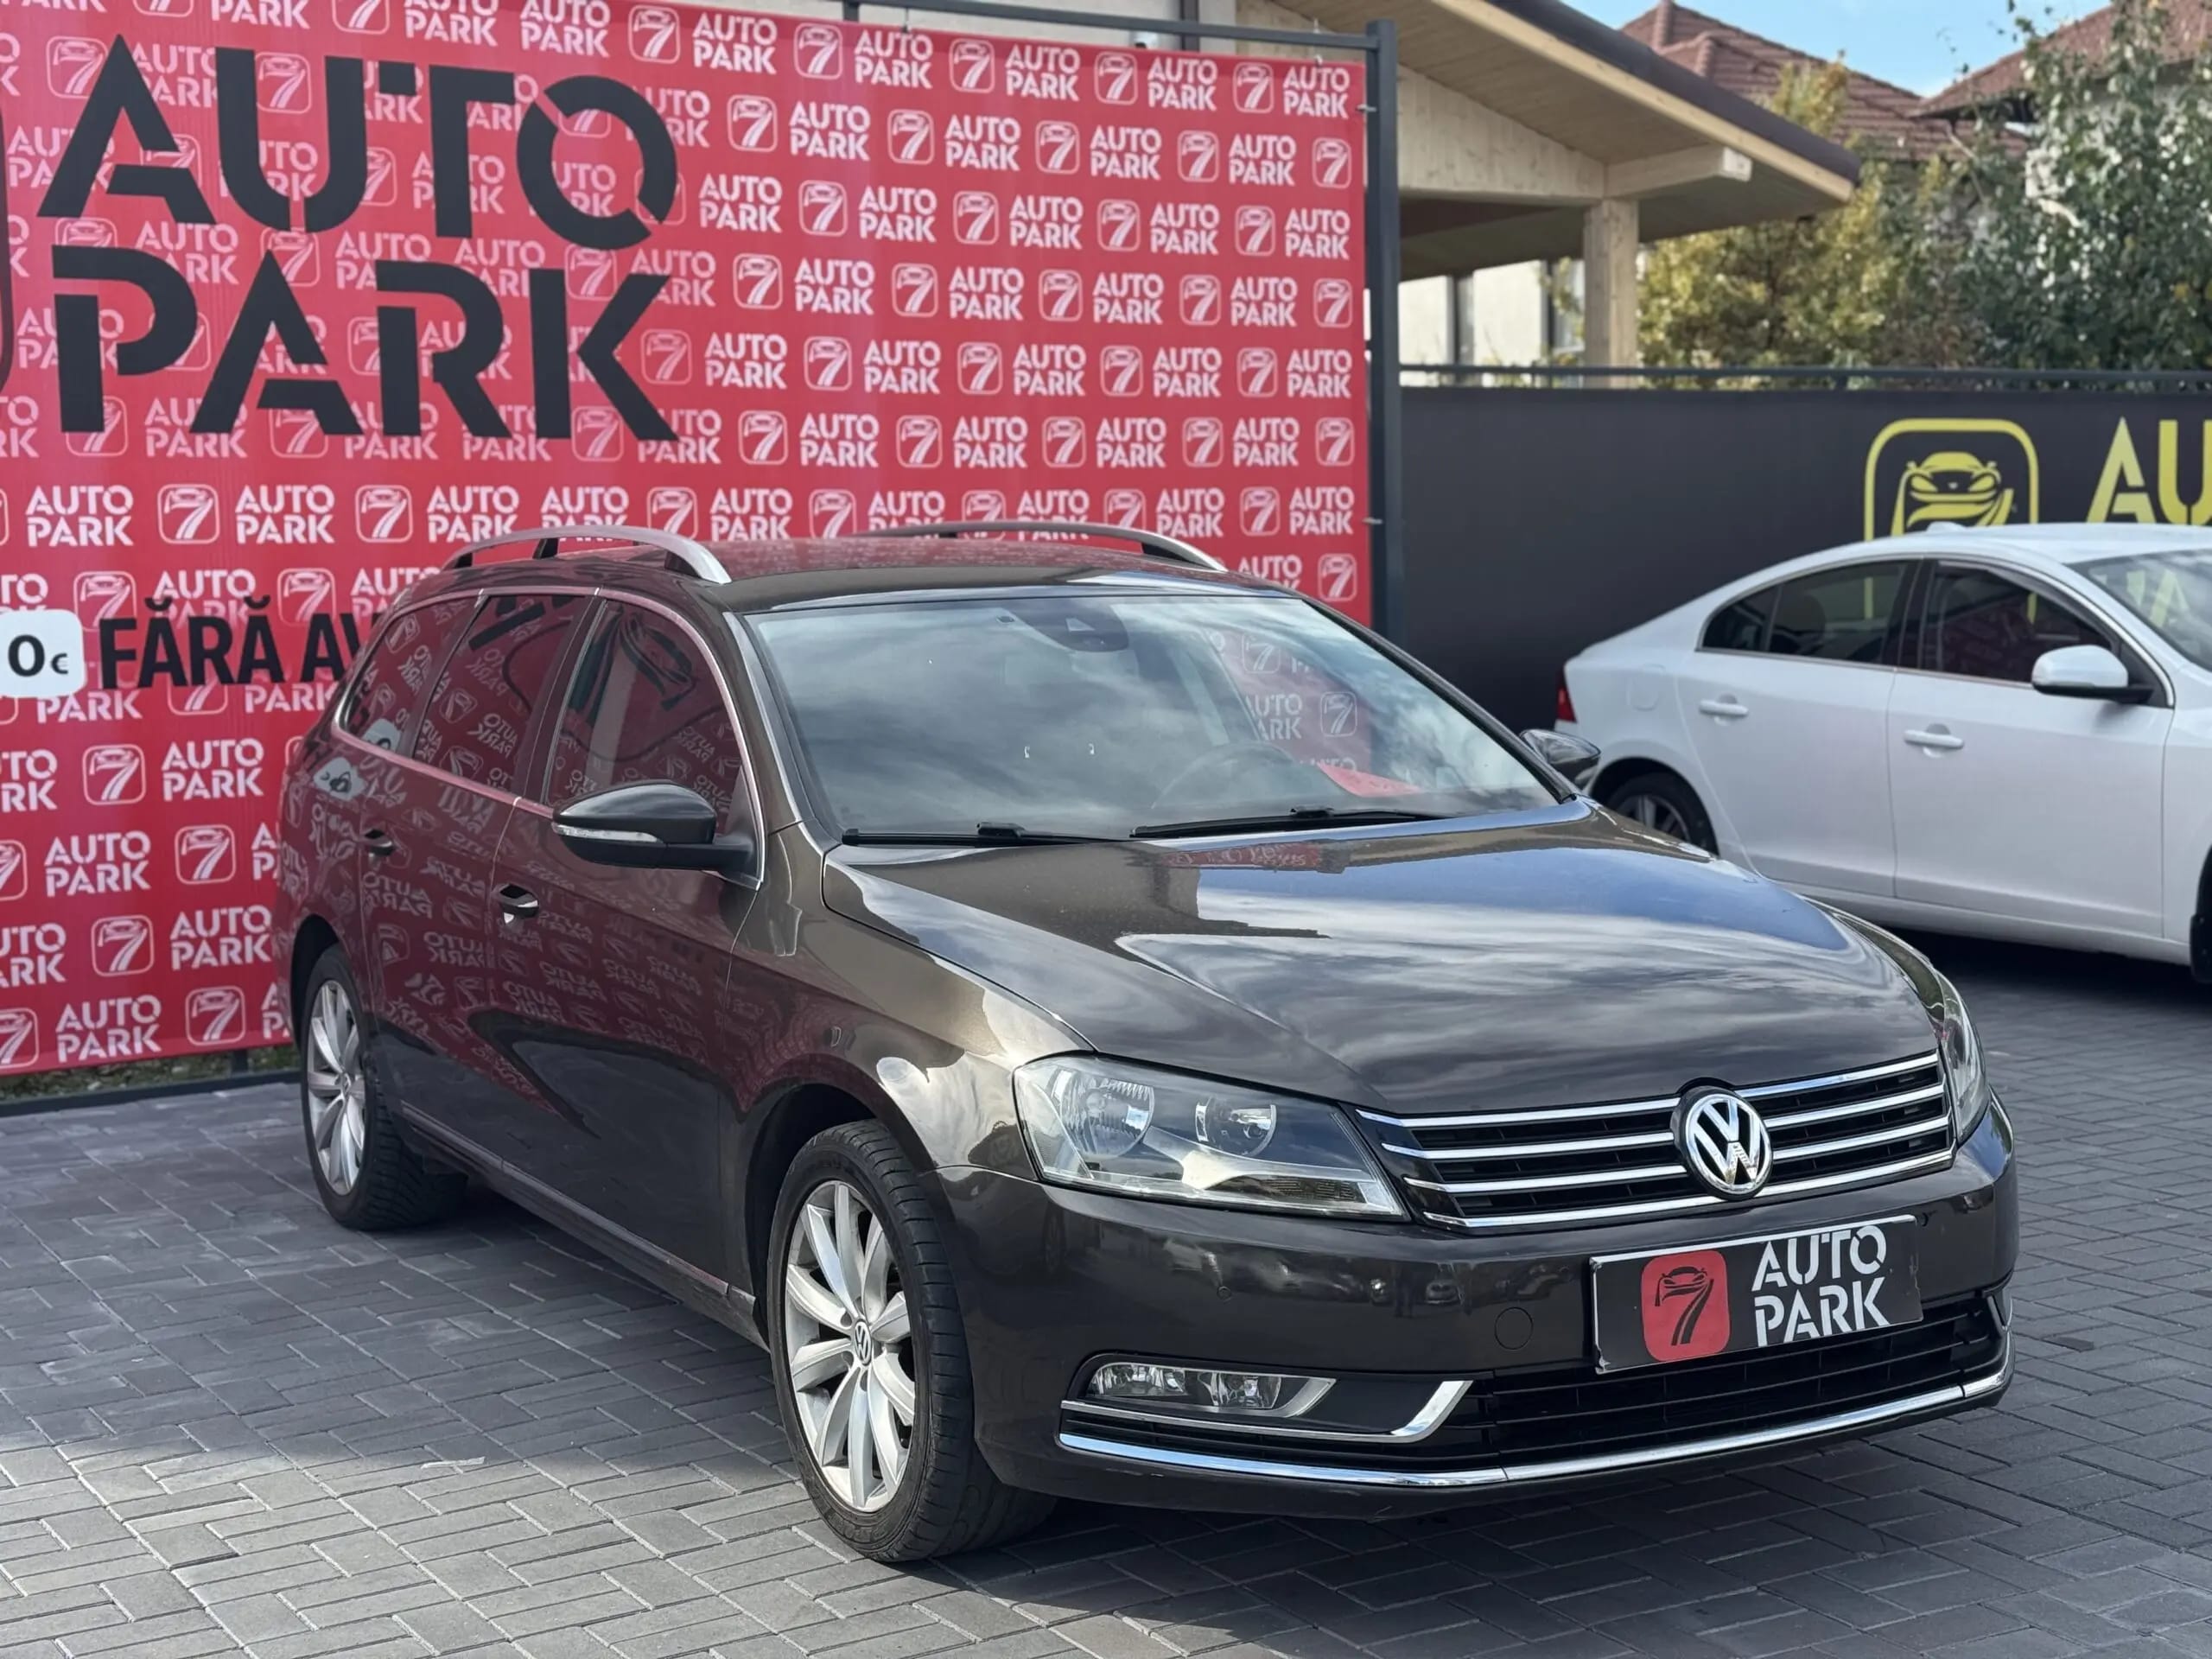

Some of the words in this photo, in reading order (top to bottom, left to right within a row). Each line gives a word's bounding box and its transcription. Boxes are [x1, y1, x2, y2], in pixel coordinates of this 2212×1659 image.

[211, 0, 310, 29] PARK
[405, 9, 499, 47] PARK
[519, 0, 611, 29] AUTO
[520, 20, 610, 58] PARK
[692, 14, 777, 46] AUTO
[693, 38, 777, 75] PARK
[854, 30, 933, 61] AUTO
[1005, 46, 1080, 74] AUTO
[855, 55, 933, 90] PARK
[1006, 68, 1079, 102] PARK
[1147, 58, 1217, 86] AUTO
[1282, 67, 1351, 93] AUTO
[1147, 80, 1217, 111] PARK
[1283, 89, 1349, 119] PARK
[789, 100, 871, 134] AUTO
[944, 114, 1021, 144] AUTO
[37, 34, 677, 251] AUTO
[790, 127, 870, 162] PARK
[945, 139, 1020, 172] PARK
[1090, 127, 1162, 155] AUTO
[1228, 137, 1297, 161] AUTO
[1090, 149, 1160, 181] PARK
[1229, 156, 1295, 187] PARK
[698, 173, 783, 205] AUTO
[858, 186, 938, 216] AUTO
[699, 200, 782, 233] PARK
[1008, 194, 1084, 224] AUTO
[1149, 202, 1220, 230] AUTO
[1284, 207, 1351, 235] AUTO
[133, 220, 239, 254] AUTO
[859, 211, 937, 243] PARK
[1009, 219, 1083, 250] PARK
[1152, 227, 1219, 256] PARK
[334, 230, 432, 263] AUTO
[453, 238, 546, 269] AUTO
[1285, 230, 1350, 260] PARK
[629, 247, 716, 279] AUTO
[794, 257, 875, 289] AUTO
[949, 266, 1025, 295] AUTO
[1092, 272, 1165, 299] AUTO
[1230, 276, 1298, 302] AUTO
[795, 283, 874, 316] PARK
[950, 292, 1024, 321] PARK
[1093, 296, 1163, 325] PARK
[1230, 300, 1297, 327] PARK
[52, 245, 680, 442] PARK
[704, 332, 788, 362] AUTO
[862, 340, 942, 368] AUTO
[1013, 344, 1087, 371] AUTO
[705, 359, 787, 390] PARK
[1155, 346, 1223, 373] AUTO
[1287, 348, 1352, 374] AUTO
[864, 365, 941, 395] PARK
[1014, 368, 1086, 397] PARK
[1155, 372, 1222, 397] PARK
[1287, 372, 1351, 399] PARK
[799, 412, 880, 442] AUTO
[952, 416, 1028, 443] AUTO
[1096, 416, 1167, 442] AUTO
[1232, 416, 1300, 443] AUTO
[145, 427, 248, 459] PARK
[344, 430, 439, 461] PARK
[462, 431, 552, 462] PARK
[638, 435, 721, 465] PARK
[800, 439, 879, 468] PARK
[953, 441, 1027, 468] PARK
[1096, 441, 1166, 468] PARK
[1233, 441, 1299, 467] PARK
[25, 484, 134, 516] AUTO
[234, 484, 335, 514] AUTO
[426, 485, 520, 514] AUTO
[540, 486, 630, 514] AUTO
[709, 487, 793, 515] AUTO
[868, 490, 947, 516] AUTO
[1017, 489, 1090, 516] AUTO
[1156, 487, 1225, 514] AUTO
[1288, 486, 1355, 512] AUTO
[27, 515, 134, 548] PARK
[236, 513, 335, 544] PARK
[710, 512, 791, 542] PARK
[1156, 512, 1224, 538] PARK
[1289, 509, 1354, 536] PARK
[1237, 556, 1304, 579] AUTO
[152, 568, 257, 600] AUTO
[99, 594, 286, 690] FĂRĂ
[37, 690, 143, 724] PARK
[161, 737, 264, 772] AUTO
[162, 766, 264, 802] PARK
[43, 830, 151, 867] AUTO
[45, 860, 150, 898] PARK
[169, 905, 272, 940] AUTO
[171, 933, 270, 970] PARK
[55, 995, 162, 1033] AUTO
[57, 1024, 162, 1064] PARK
[1751, 1224, 1887, 1292] AUTO
[1752, 1277, 1891, 1348] PARK
